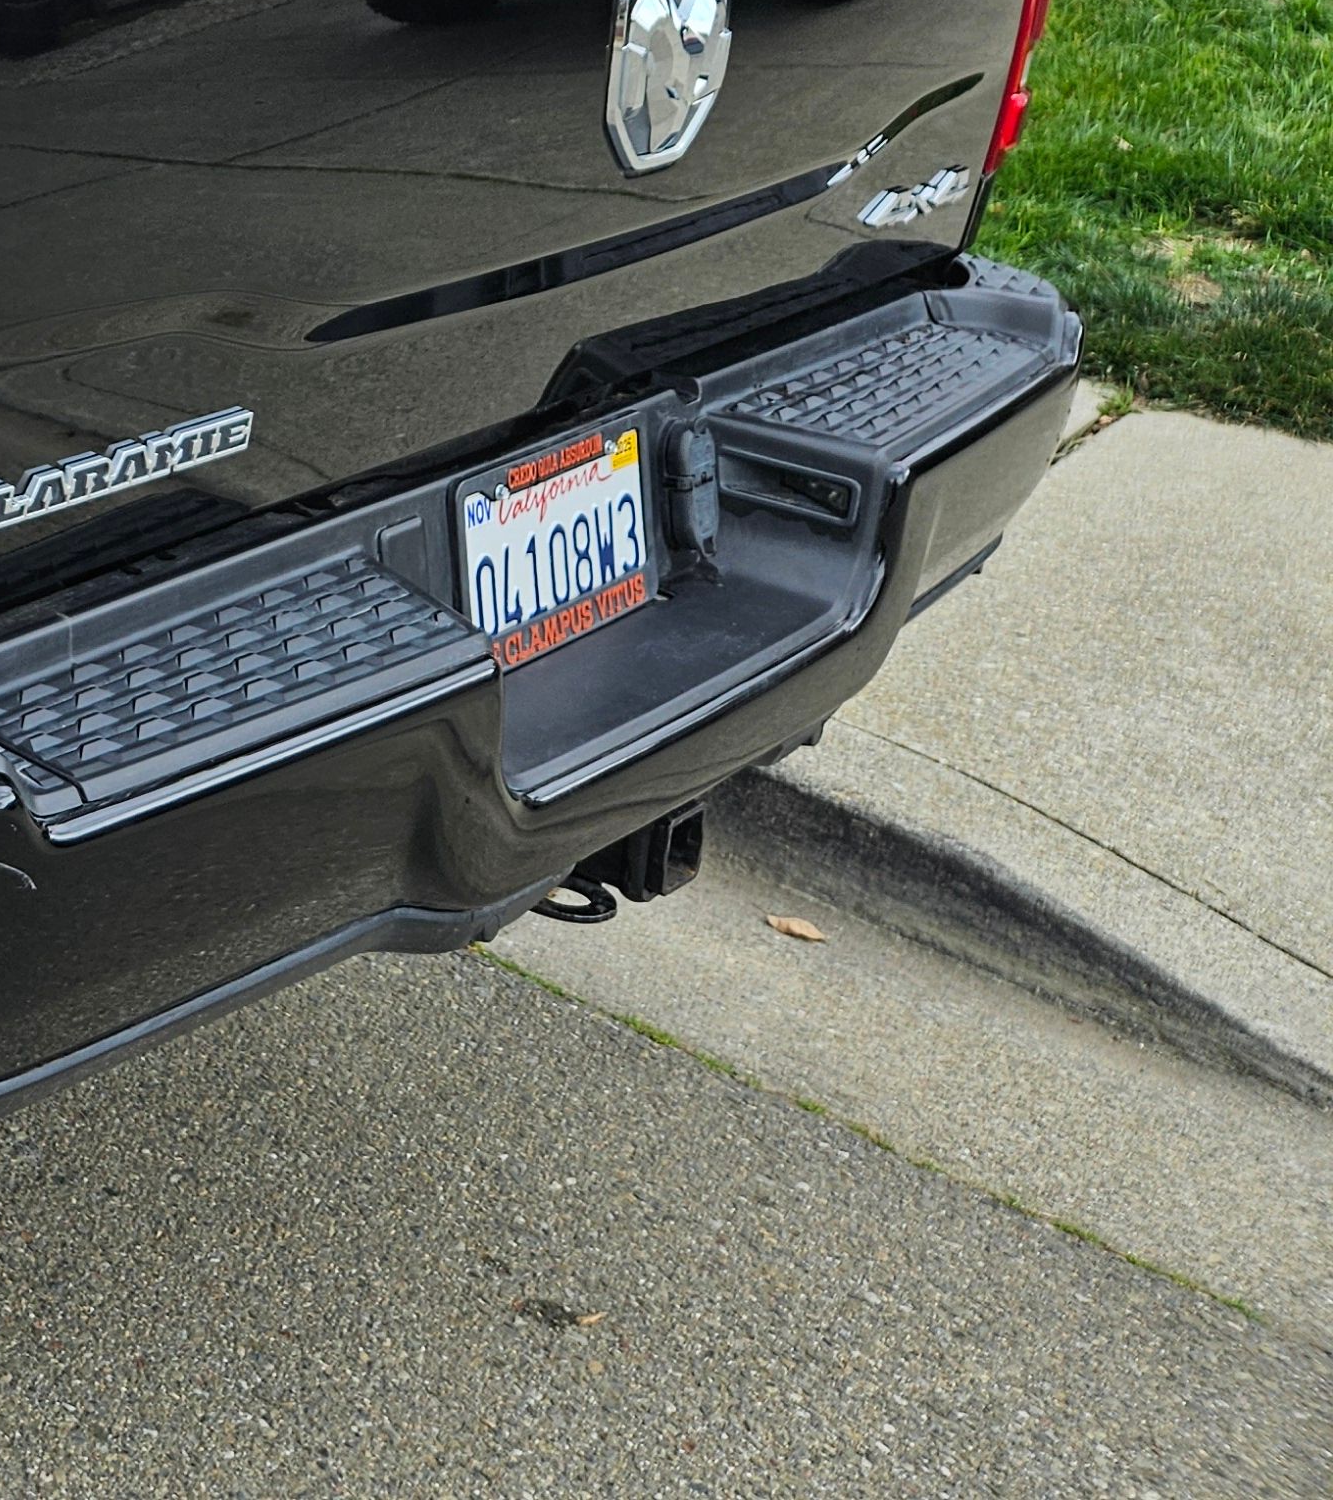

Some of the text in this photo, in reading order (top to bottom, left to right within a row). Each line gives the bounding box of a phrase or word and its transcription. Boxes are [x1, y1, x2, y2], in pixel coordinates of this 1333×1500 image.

[498, 463, 614, 526] California
[507, 462, 537, 489] CREDO
[468, 498, 493, 529] NOV
[476, 492, 641, 636] 04108W3
[504, 599, 594, 666] CLAMPUS
[595, 572, 647, 620] VITUS
